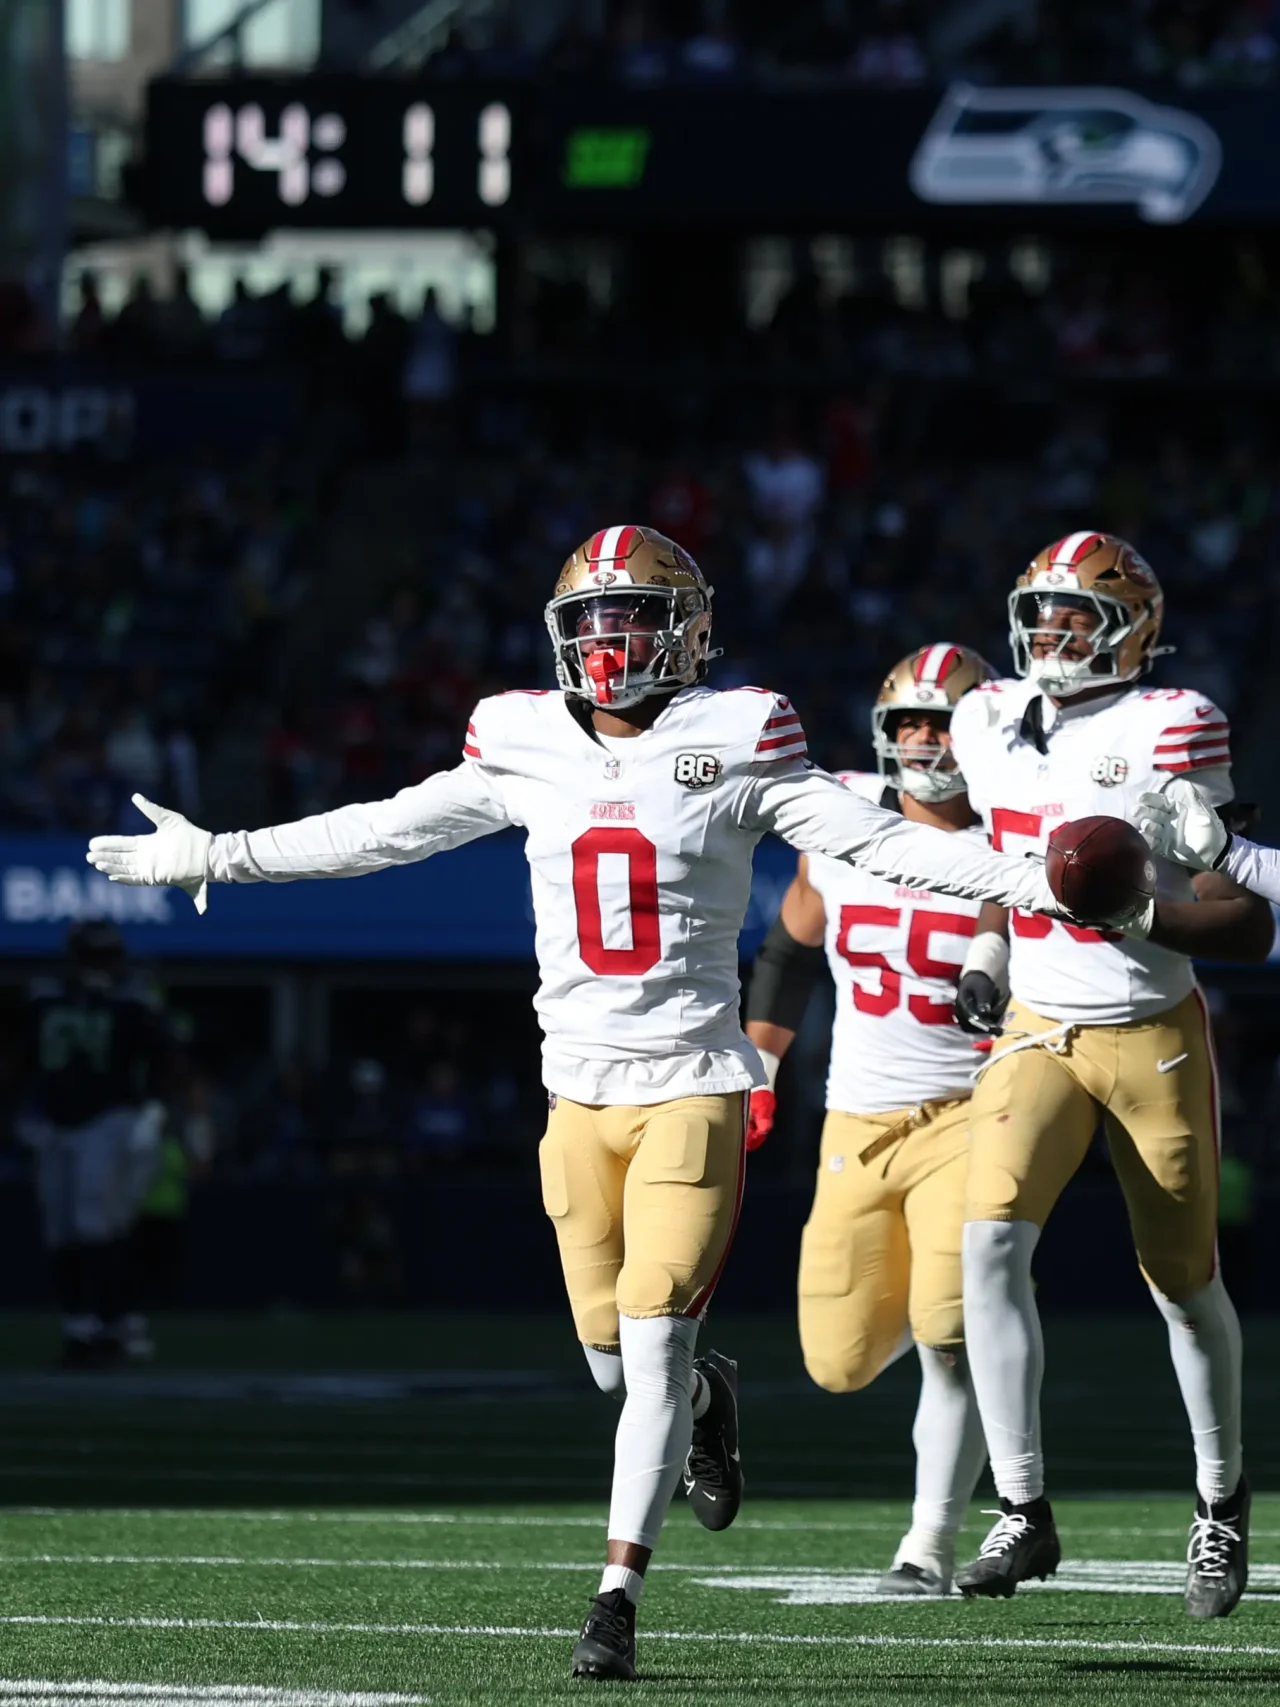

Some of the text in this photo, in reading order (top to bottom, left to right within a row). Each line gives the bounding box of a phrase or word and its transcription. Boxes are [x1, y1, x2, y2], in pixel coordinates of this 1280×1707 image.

[590, 803, 636, 820] 49ERS
[2, 864, 176, 925] BANK
[572, 827, 662, 976] 0
[836, 904, 981, 1026] 55
